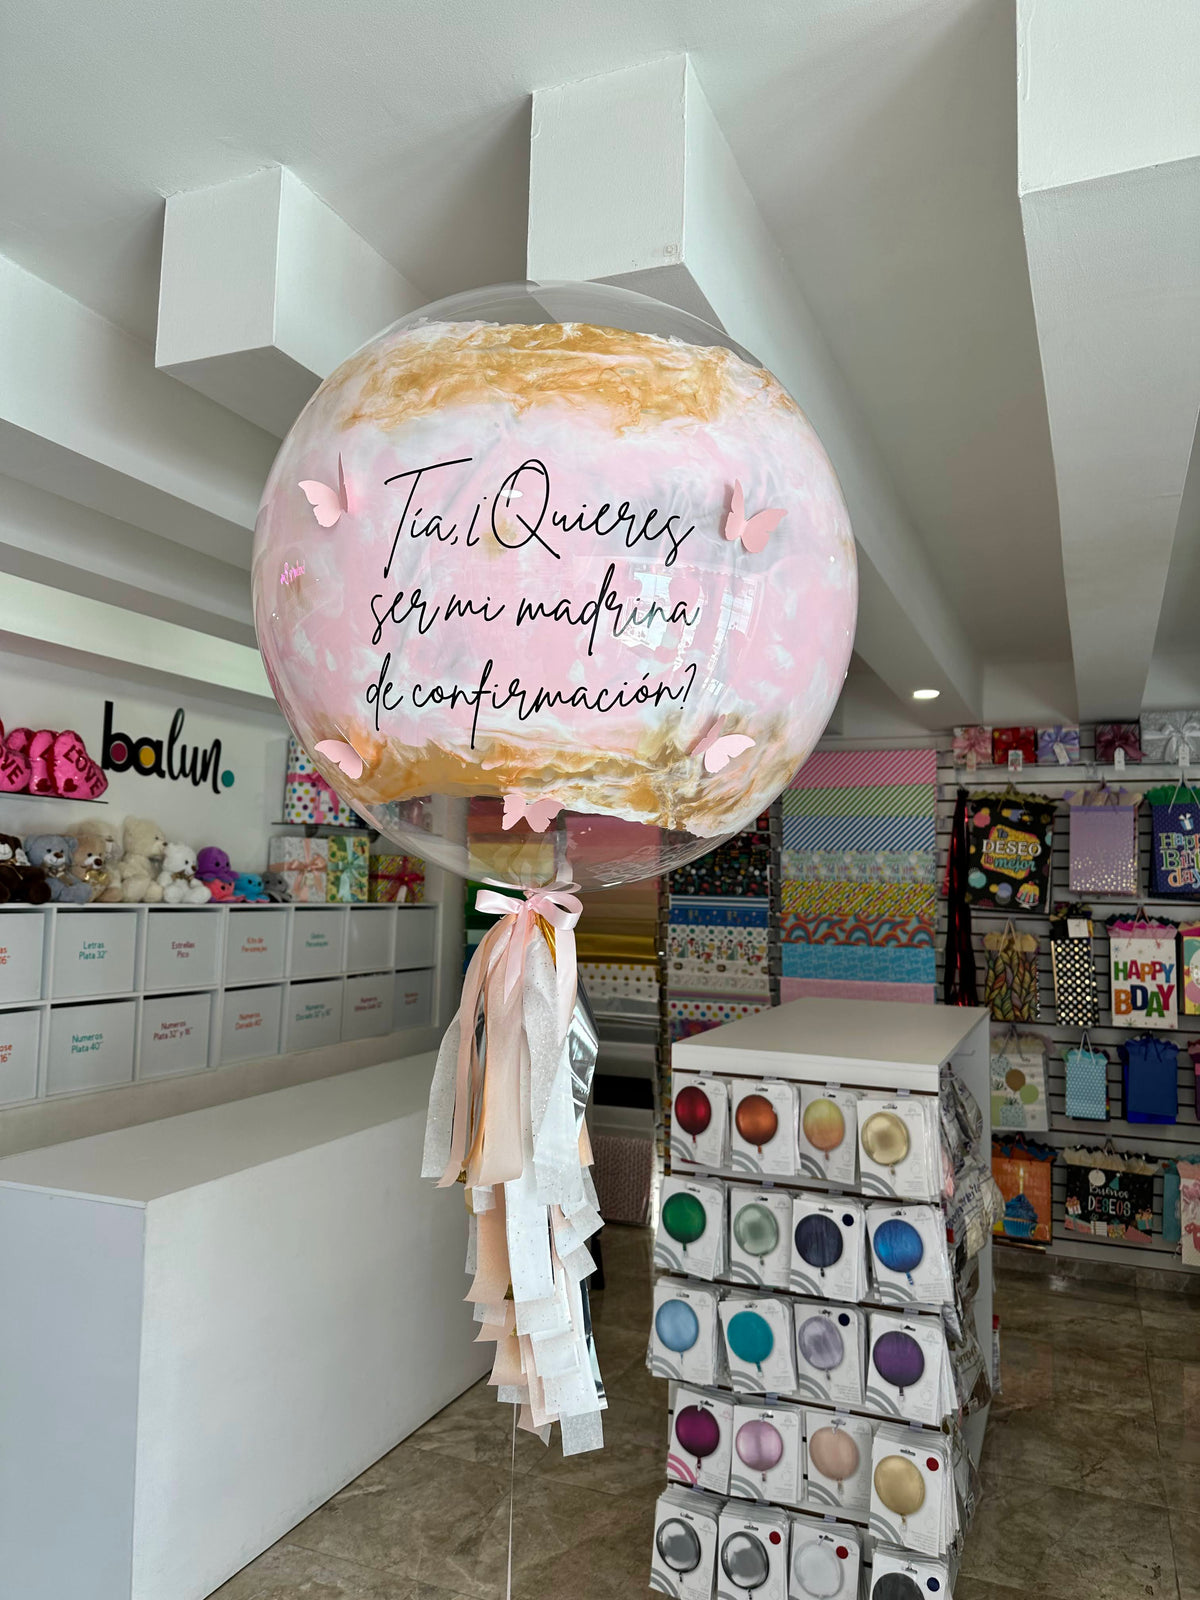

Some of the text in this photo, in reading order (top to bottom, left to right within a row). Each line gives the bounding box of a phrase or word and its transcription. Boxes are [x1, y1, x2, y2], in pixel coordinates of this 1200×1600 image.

[370, 562, 701, 657] ser mi madrina
[366, 651, 698, 751] de confirmación?
[62, 743, 105, 797] LOVE
[981, 839, 1043, 857] DESEO
[994, 856, 1037, 873] mejor
[78, 951, 96, 960] Plata
[83, 941, 105, 950] Letras
[1113, 959, 1175, 983] HAPPY
[1114, 983, 1176, 1018] BDAY
[71, 1032, 104, 1044] Numeros
[71, 1044, 89, 1053] Plata
[1087, 1195, 1131, 1217] DESEOS
